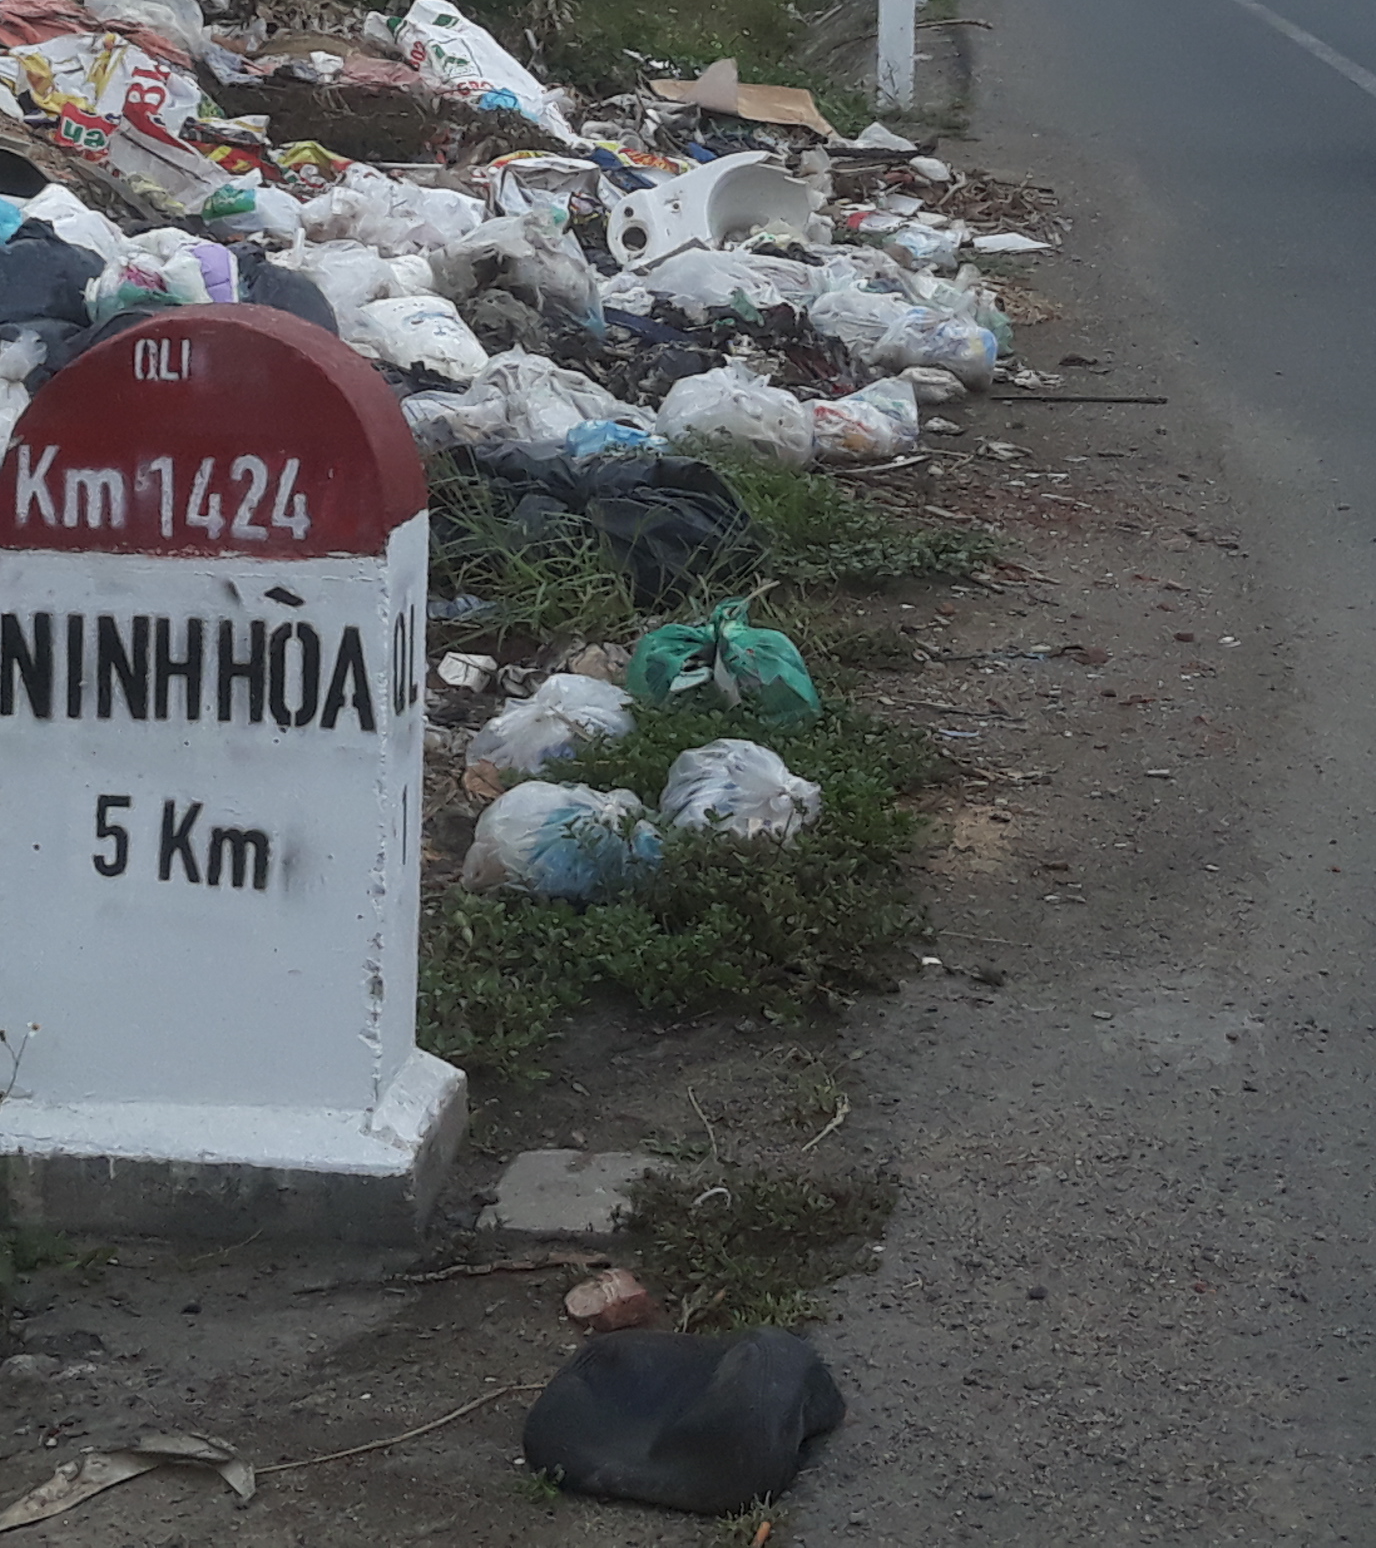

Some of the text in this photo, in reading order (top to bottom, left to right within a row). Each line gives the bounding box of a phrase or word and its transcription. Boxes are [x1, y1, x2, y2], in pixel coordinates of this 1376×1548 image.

[15, 444, 312, 541] Km 1424
[92, 793, 271, 891] 5 Km
